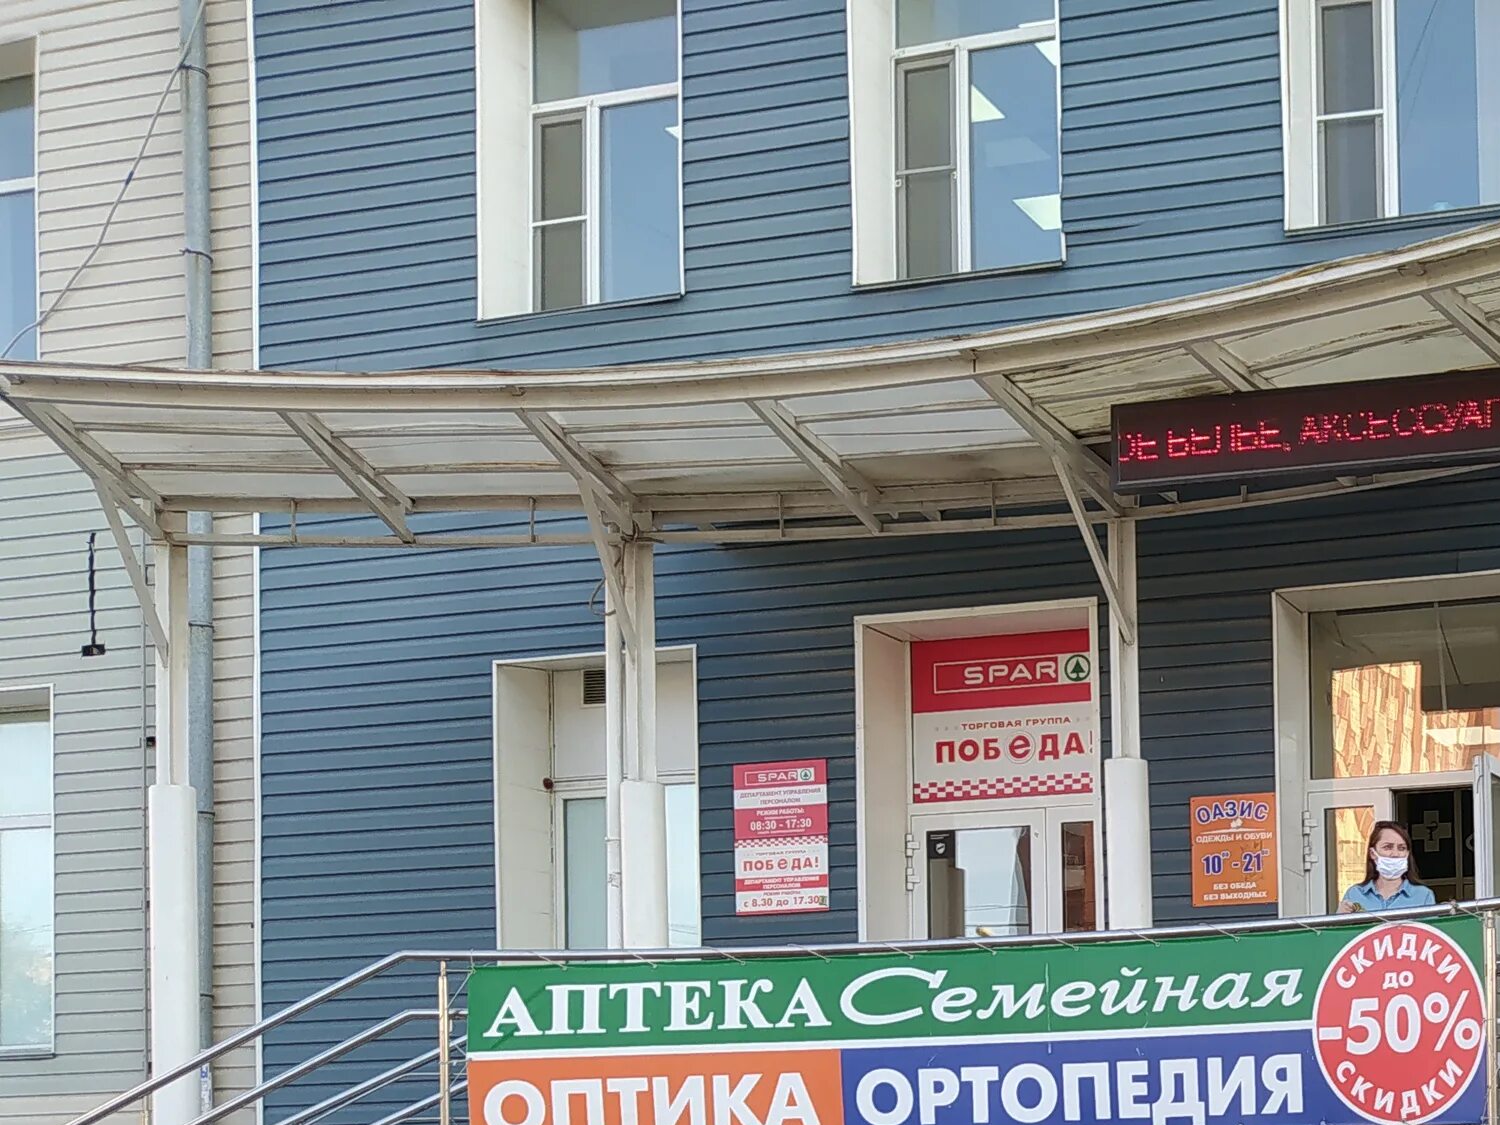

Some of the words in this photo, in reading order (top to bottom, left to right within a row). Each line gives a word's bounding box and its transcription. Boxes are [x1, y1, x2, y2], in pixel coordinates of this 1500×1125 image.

[963, 660, 1057, 685] SPAR
[960, 719, 1023, 731] ТОРГОВАЯ
[1025, 716, 1072, 728] ГРУППА
[757, 771, 798, 783] SPAR
[1196, 800, 1269, 824] ОАЗИС
[750, 820, 777, 831] 08:30
[785, 818, 812, 829] 17:30
[1243, 832, 1273, 840] ОБУВИ
[751, 898, 773, 907] 8.30
[776, 899, 789, 907] до
[1203, 893, 1219, 901] БЕЗ
[1336, 932, 1463, 989] СКИДКИ
[1381, 970, 1415, 990] до
[482, 976, 832, 1038] АПТЕКА
[839, 966, 1304, 1026] Семейная
[1318, 990, 1481, 1056] -50%
[1336, 1057, 1464, 1119] СКИДКИ
